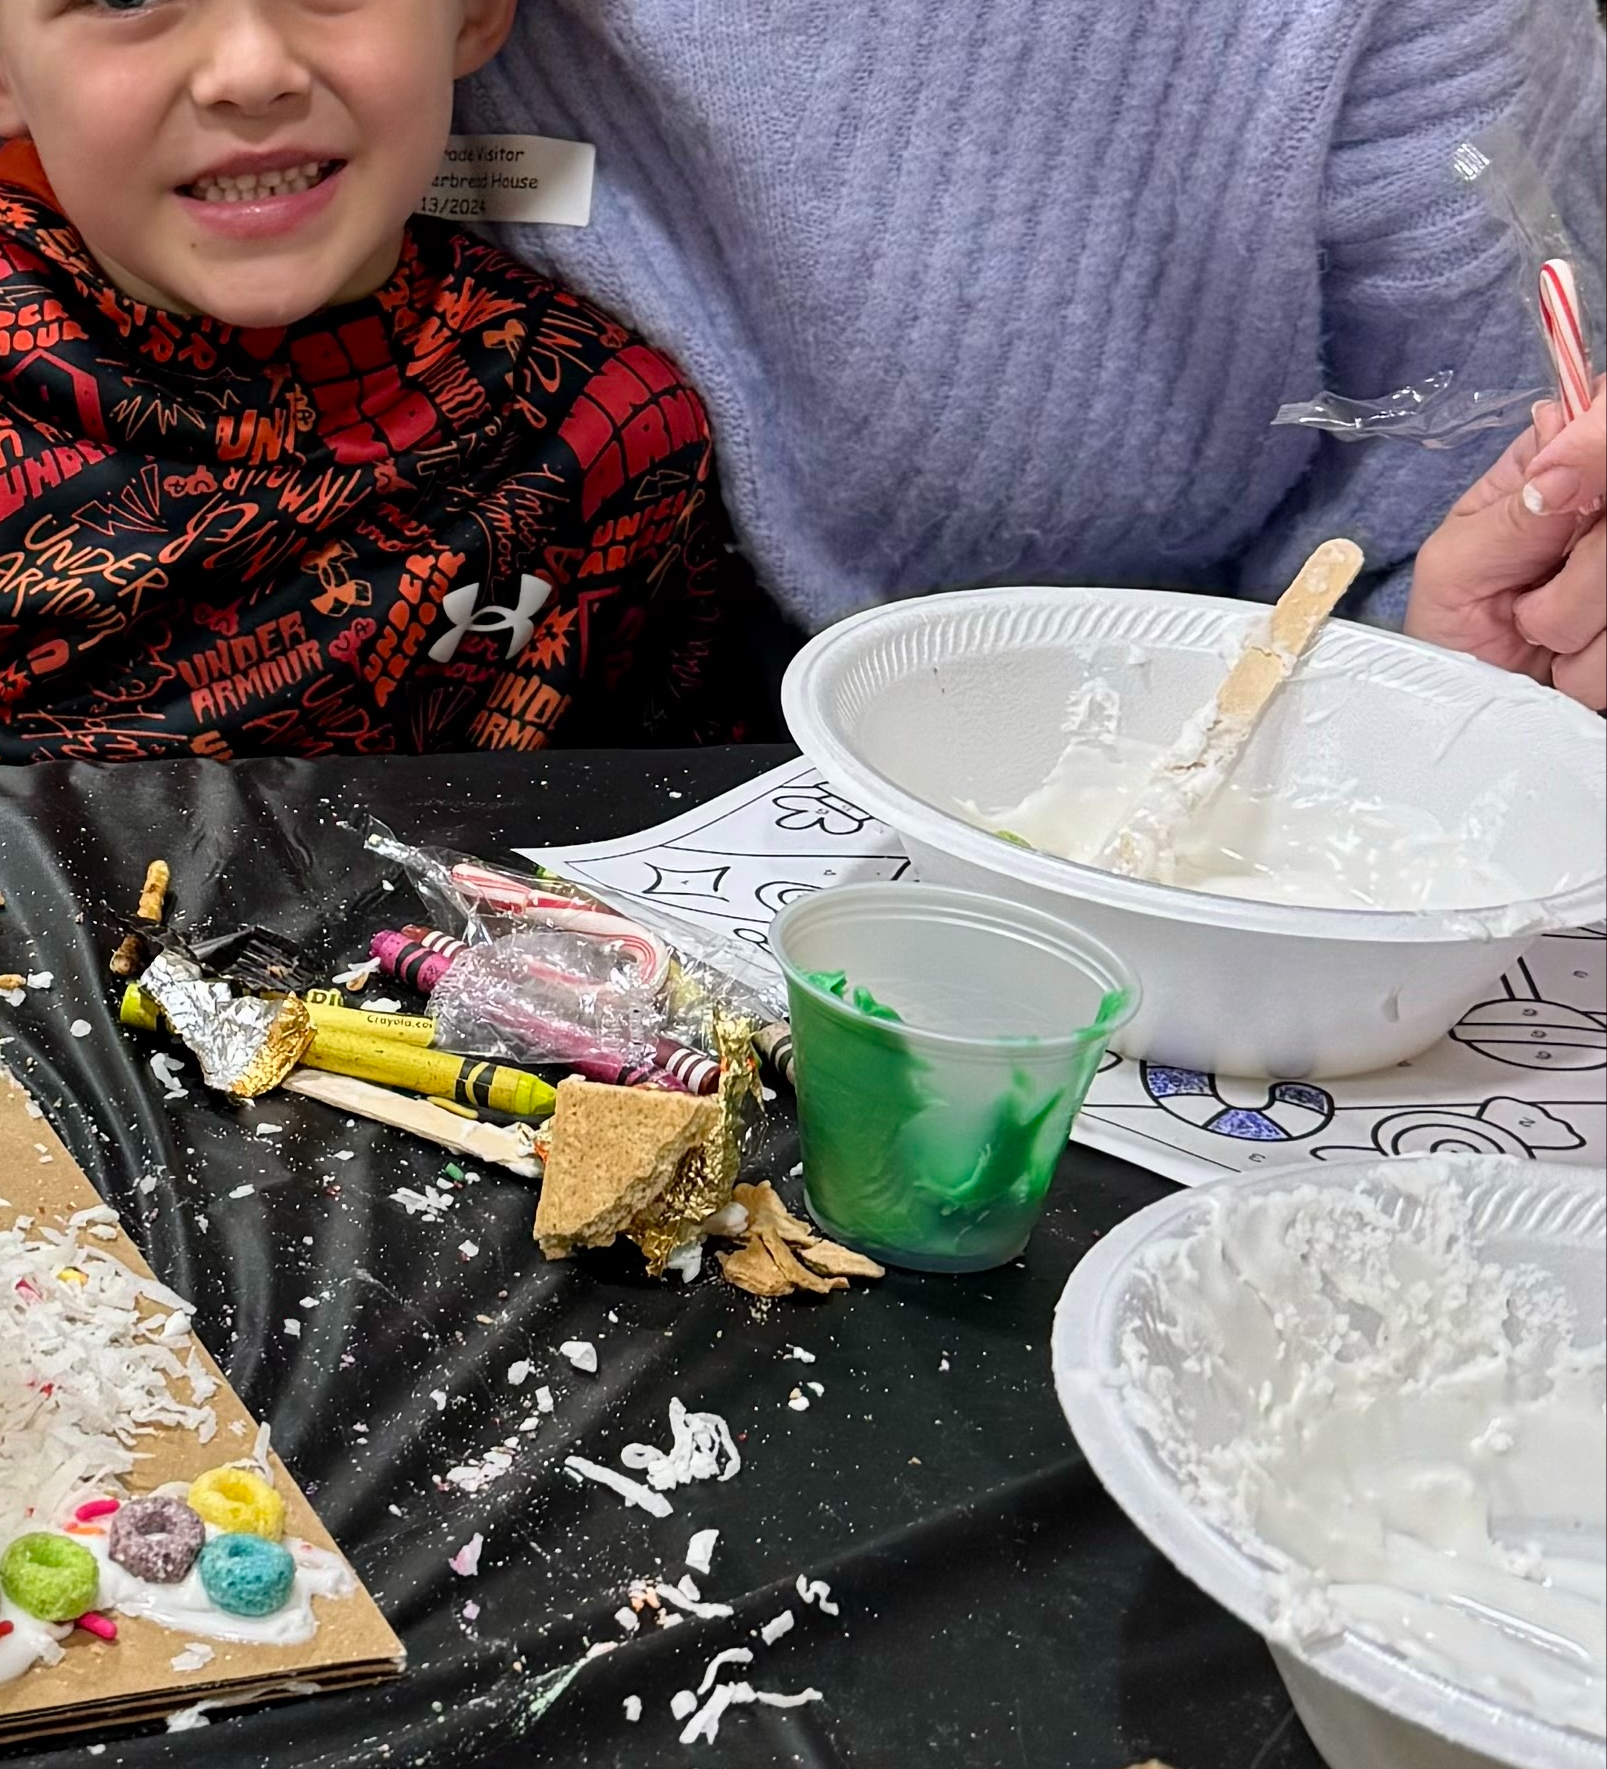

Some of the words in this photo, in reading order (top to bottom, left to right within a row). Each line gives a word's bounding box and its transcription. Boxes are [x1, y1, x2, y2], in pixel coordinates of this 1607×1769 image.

[491, 173, 538, 189] House
[24, 513, 169, 617] UNDER
[177, 610, 306, 688] UNDER
[190, 639, 324, 724] ARMOUR
